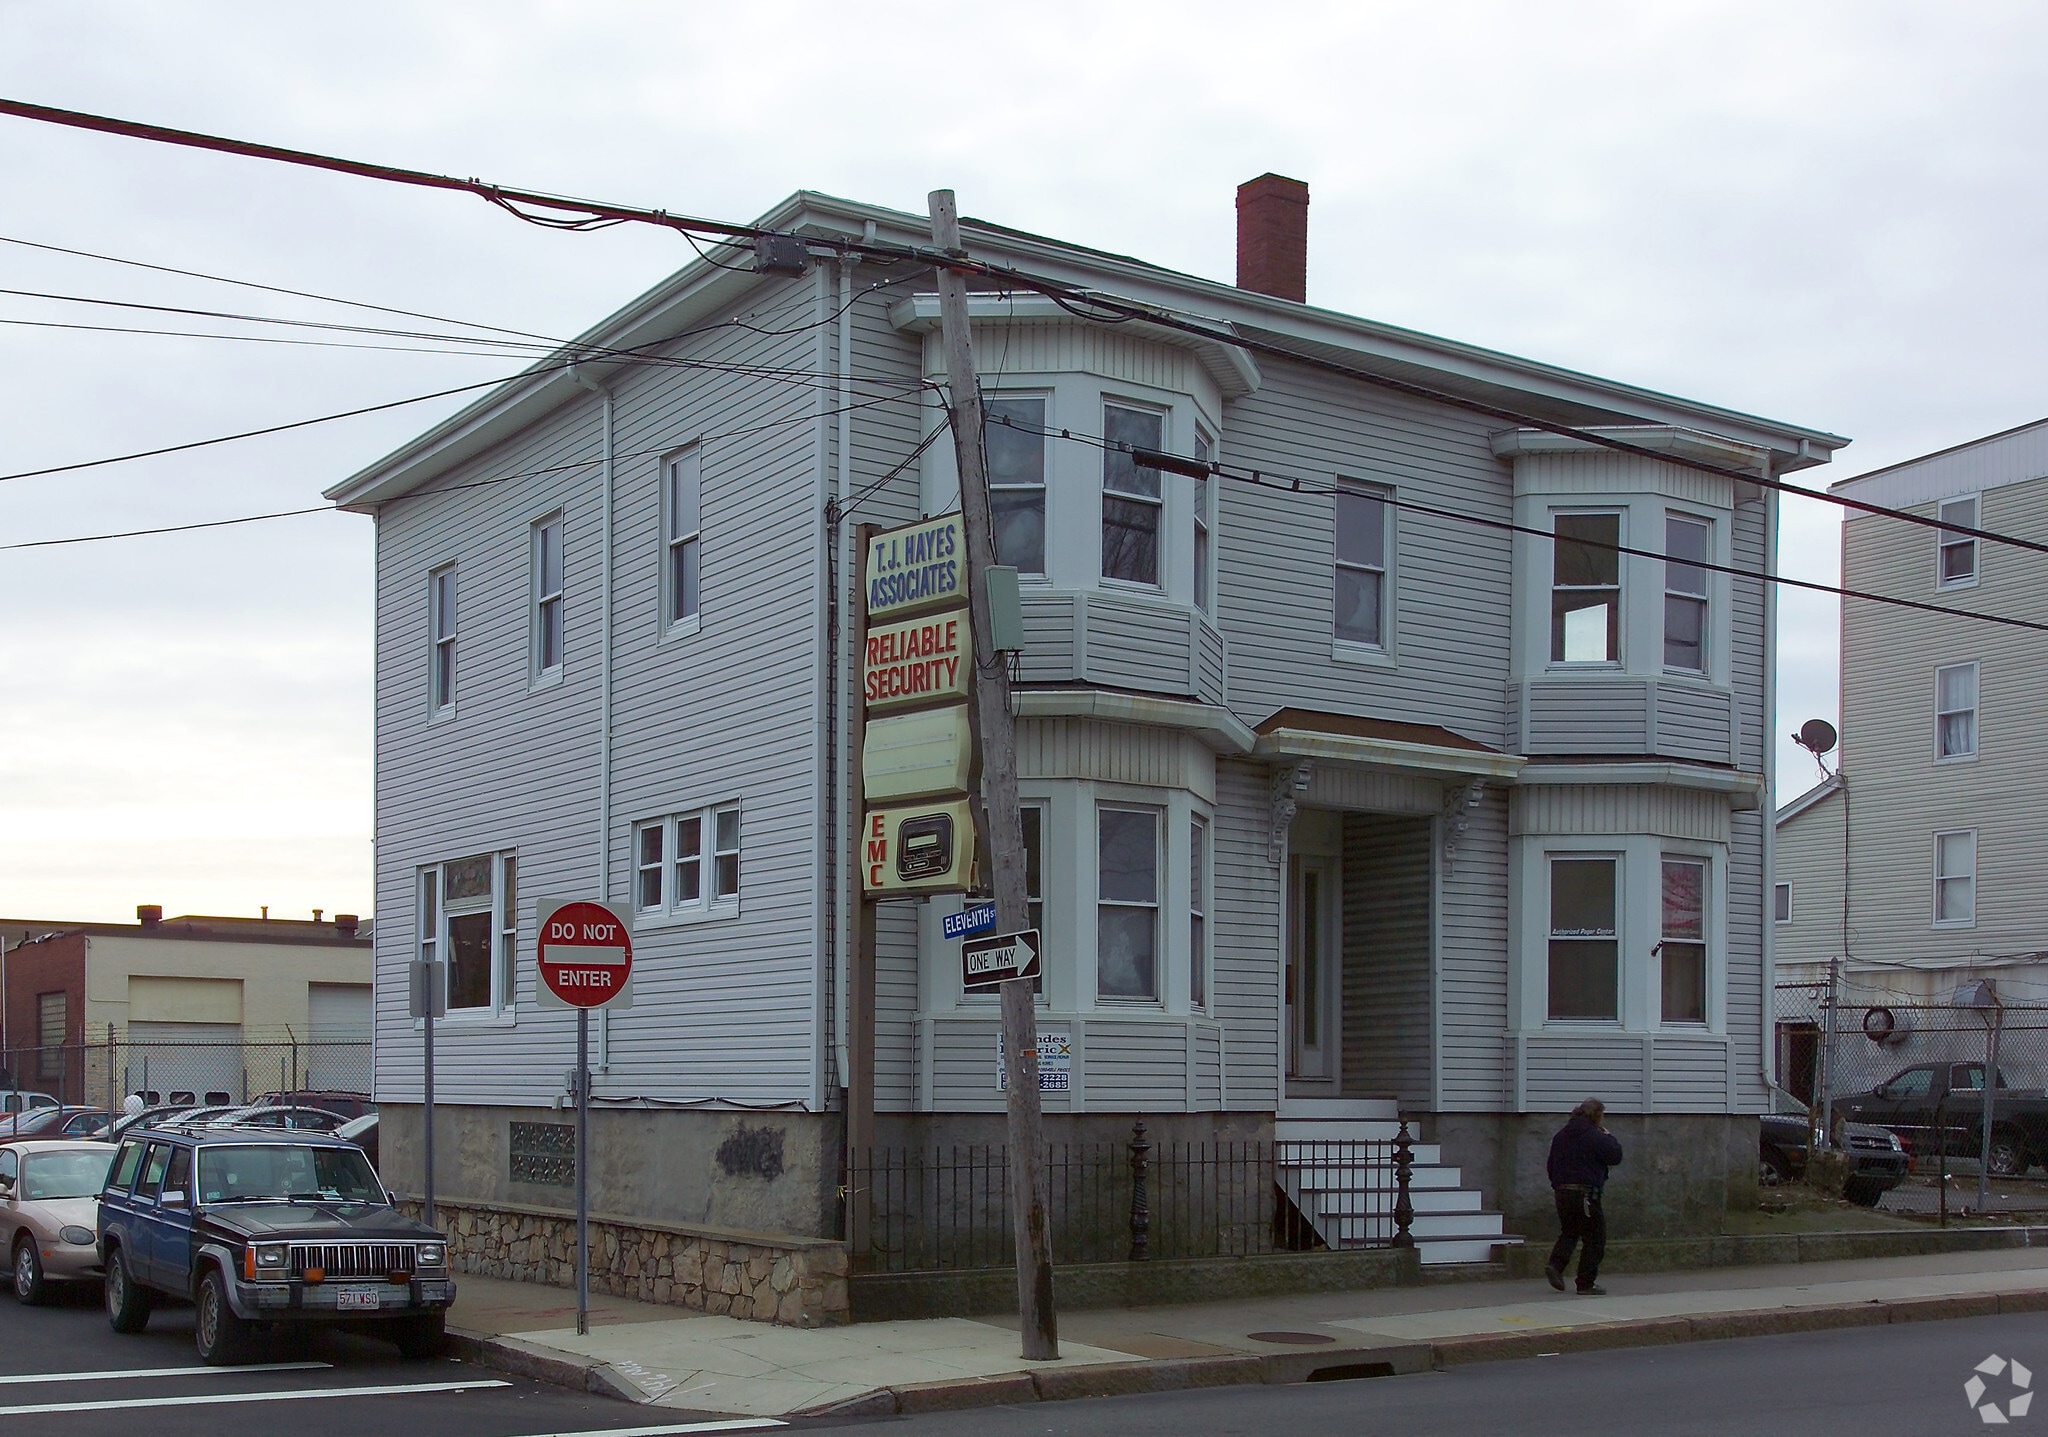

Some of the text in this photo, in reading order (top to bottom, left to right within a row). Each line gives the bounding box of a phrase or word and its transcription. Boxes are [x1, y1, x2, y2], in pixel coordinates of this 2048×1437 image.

[876, 524, 955, 572] T.J. HAYES
[870, 560, 956, 609] ASSOCIATES
[867, 620, 957, 667] RELIABLE
[866, 655, 960, 701] SECURITY
[551, 922, 617, 941] DO NOT
[945, 907, 990, 934] ELEVENTH
[970, 948, 1016, 971] ONE WAY
[559, 969, 611, 987] ENTER
